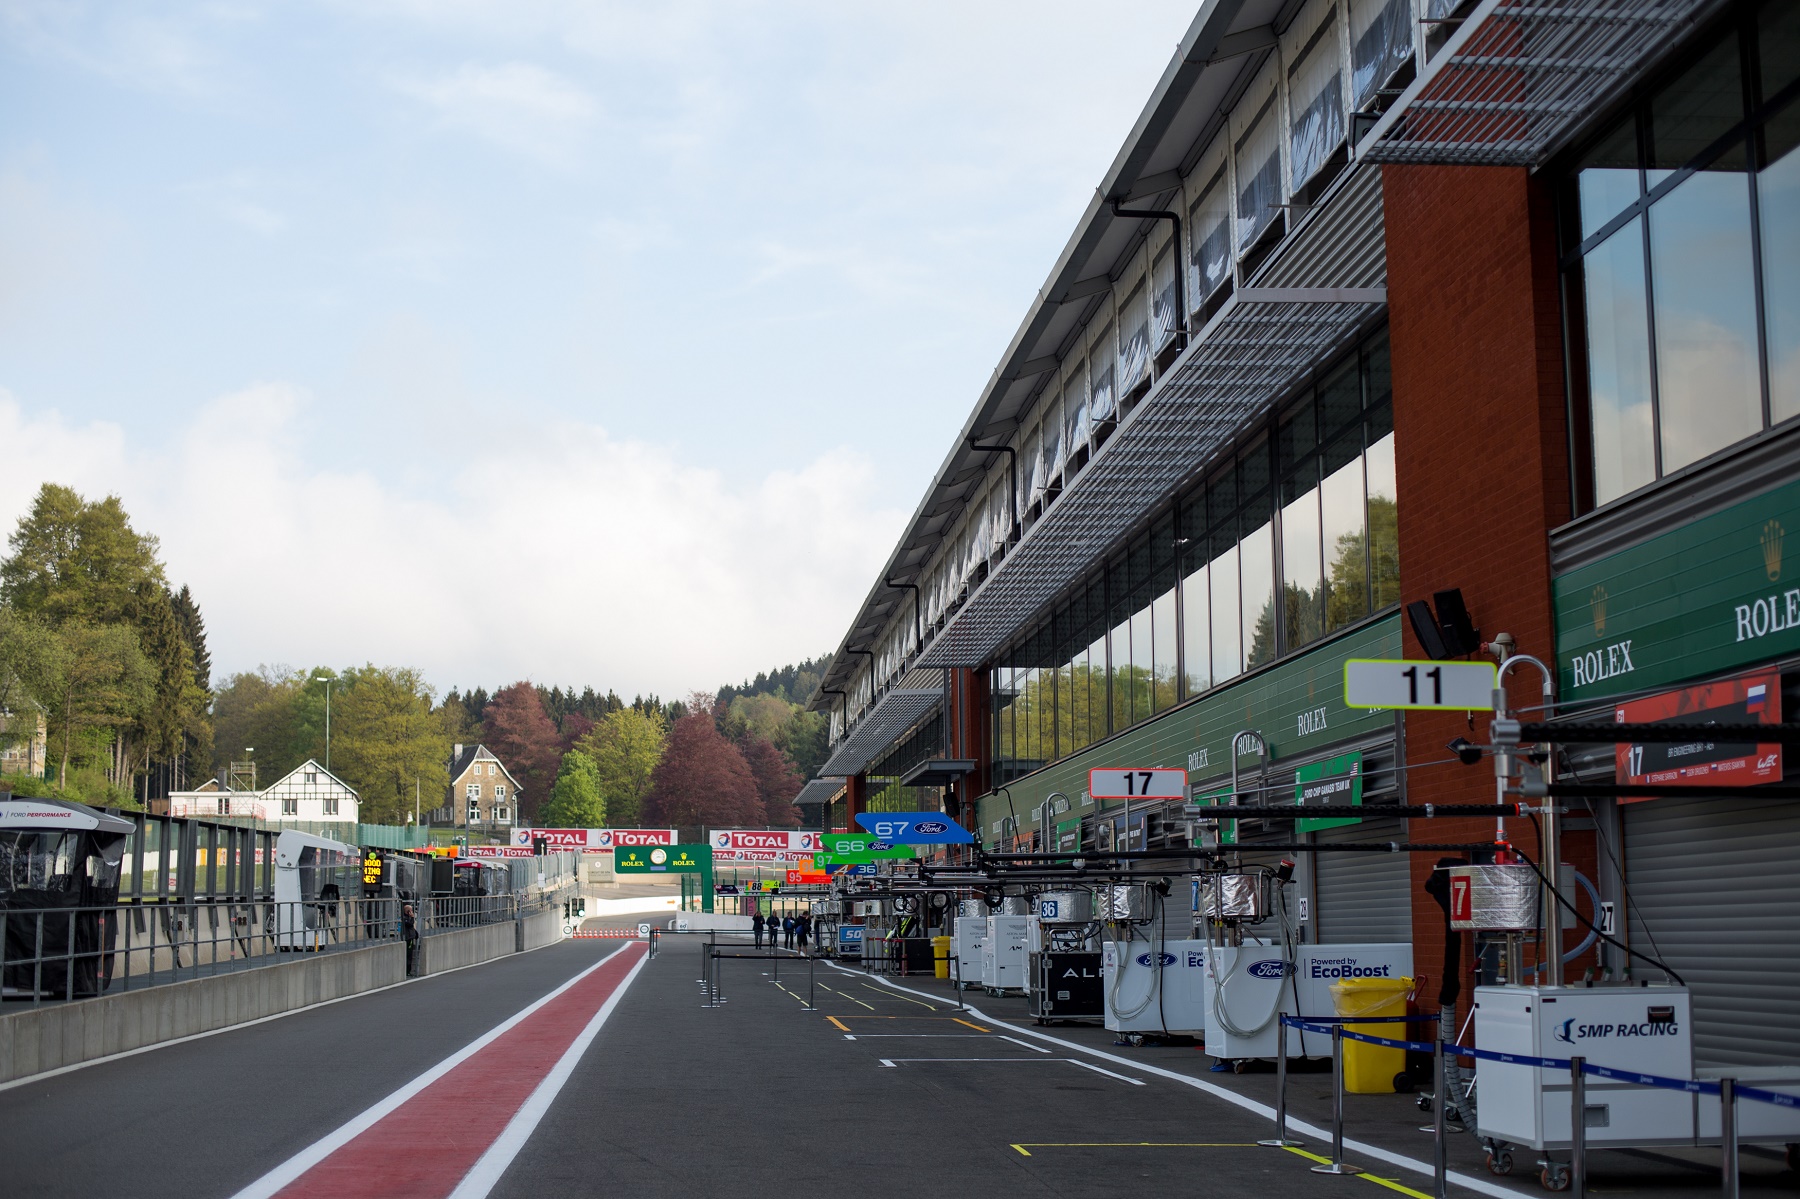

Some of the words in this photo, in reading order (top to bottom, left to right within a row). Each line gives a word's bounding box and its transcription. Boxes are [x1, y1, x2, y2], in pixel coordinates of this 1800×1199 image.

[1572, 640, 1635, 687] ROLEX
[1402, 666, 1442, 704] 11
[1298, 707, 1327, 736] ROLEX
[1188, 748, 1208, 771] ROLEX
[1628, 746, 1643, 776] 17
[1124, 772, 1153, 795] 17
[875, 822, 909, 835] 67
[920, 823, 941, 832] Ford
[615, 832, 669, 845] TOTAL
[734, 833, 787, 847] TOTAL
[836, 841, 864, 852] 66
[744, 851, 775, 860] TOTAL
[817, 855, 832, 867] 97
[789, 872, 802, 882] 95
[1042, 902, 1056, 917] 36
[1601, 906, 1613, 931] 27
[1578, 1025, 1613, 1038] SMP
[1616, 1023, 1678, 1036] RACING
